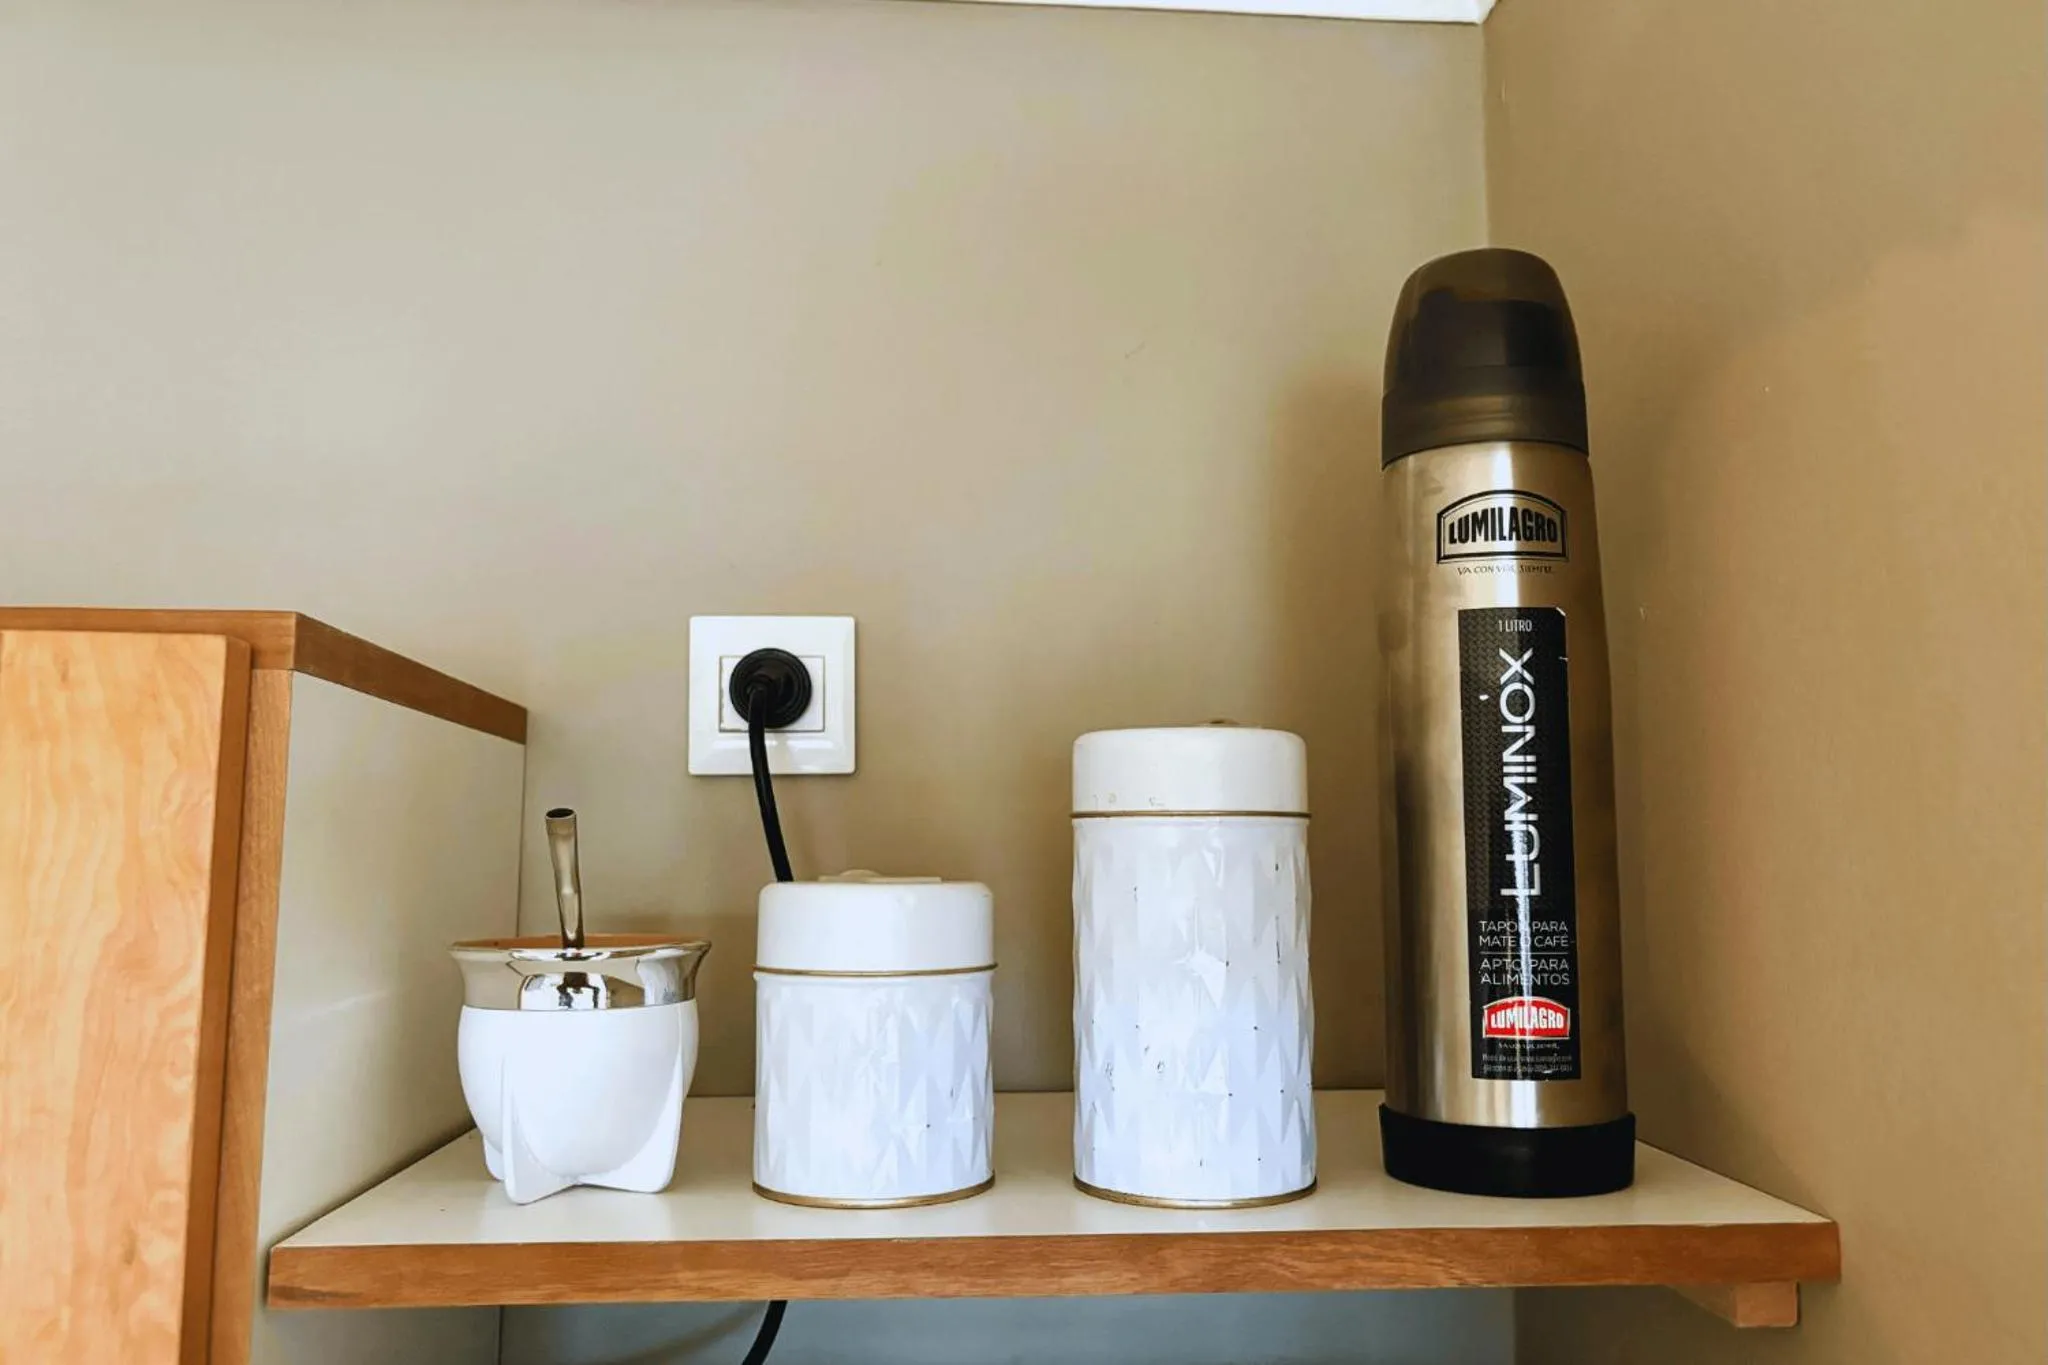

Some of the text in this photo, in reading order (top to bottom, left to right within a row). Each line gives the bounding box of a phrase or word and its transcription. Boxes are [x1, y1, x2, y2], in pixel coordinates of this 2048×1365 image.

[1448, 506, 1558, 544] LUMILAGRO
[1474, 565, 1494, 574] CON
[1498, 619, 1533, 632] 1 LITRO
[1499, 647, 1541, 896] LUMINOX
[1479, 920, 1568, 933] TAPO PARA
[1479, 935, 1517, 947] MATE
[1533, 932, 1569, 947] CAFÉ
[1480, 958, 1569, 971] APTO PARA
[1480, 973, 1570, 986] ALIMENTOS
[1490, 1005, 1564, 1029] LUMILAGRO
